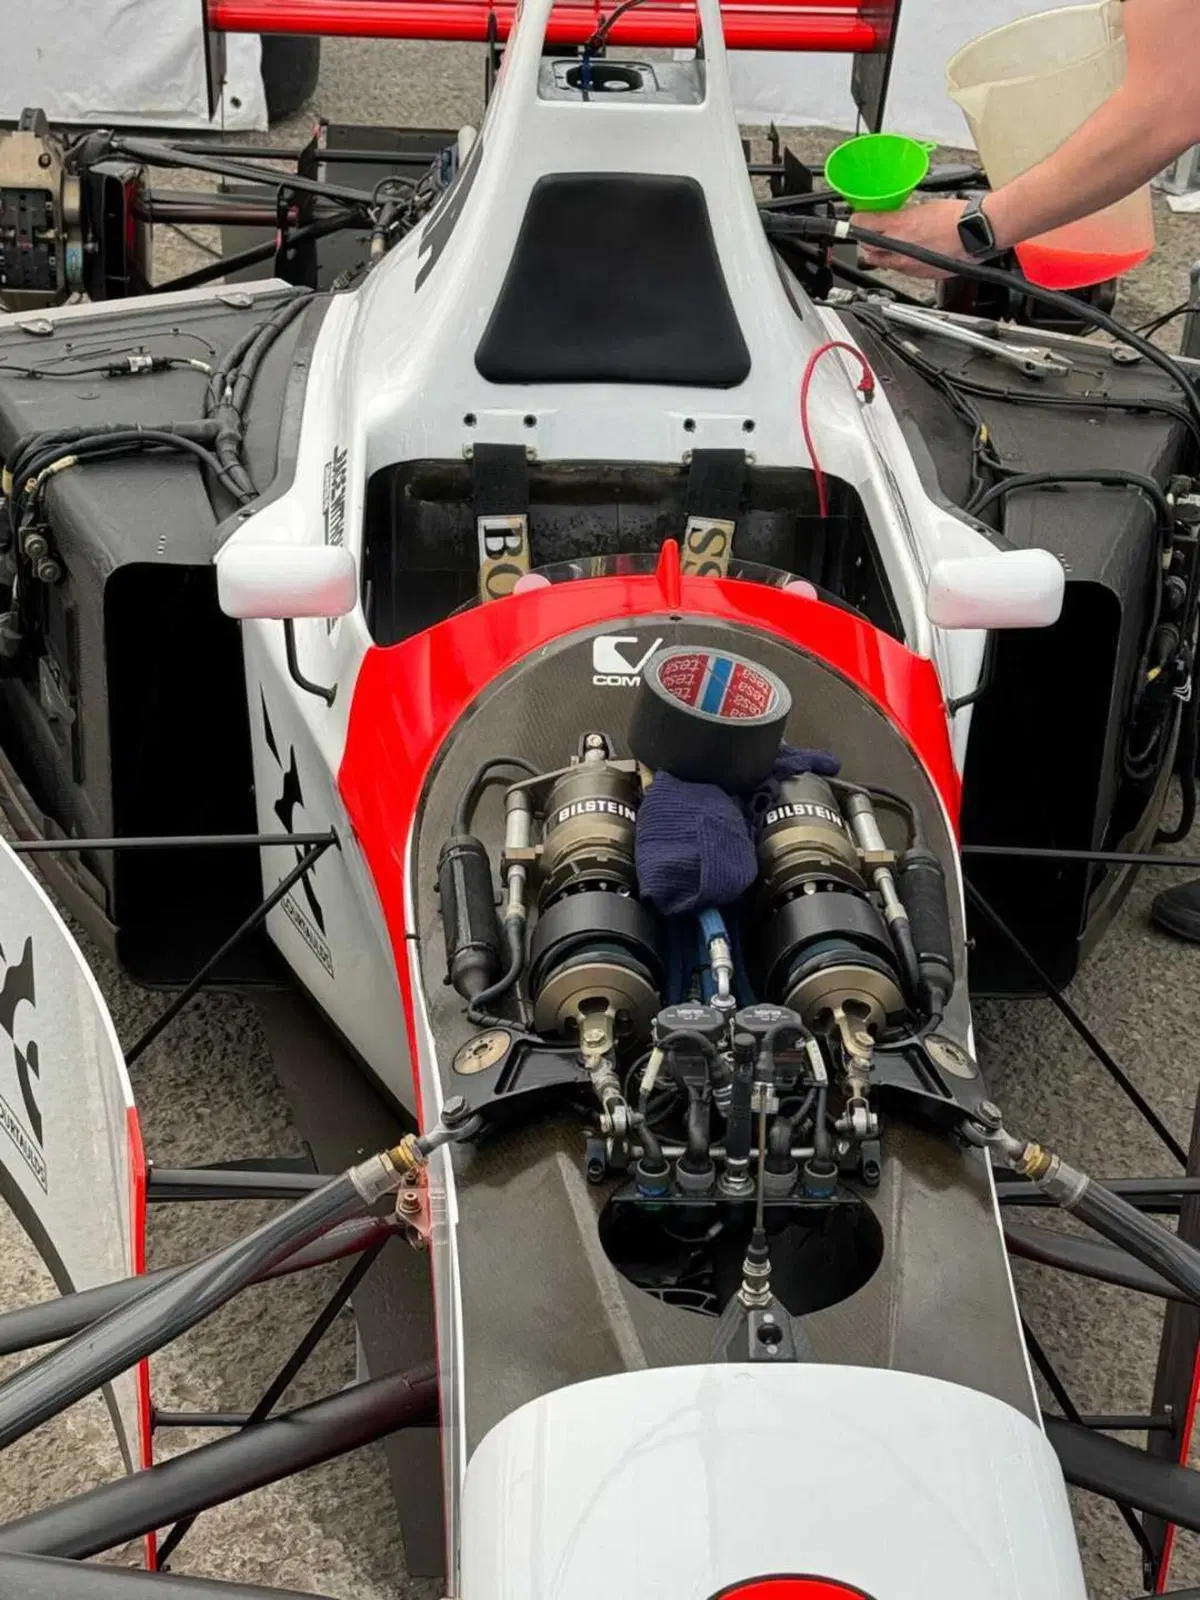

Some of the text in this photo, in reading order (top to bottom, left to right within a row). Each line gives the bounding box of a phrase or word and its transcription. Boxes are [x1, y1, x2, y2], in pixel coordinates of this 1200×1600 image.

[738, 681, 765, 708] tesa
[558, 800, 636, 822] BILSTEIN
[766, 803, 842, 826] BILSTEIN
